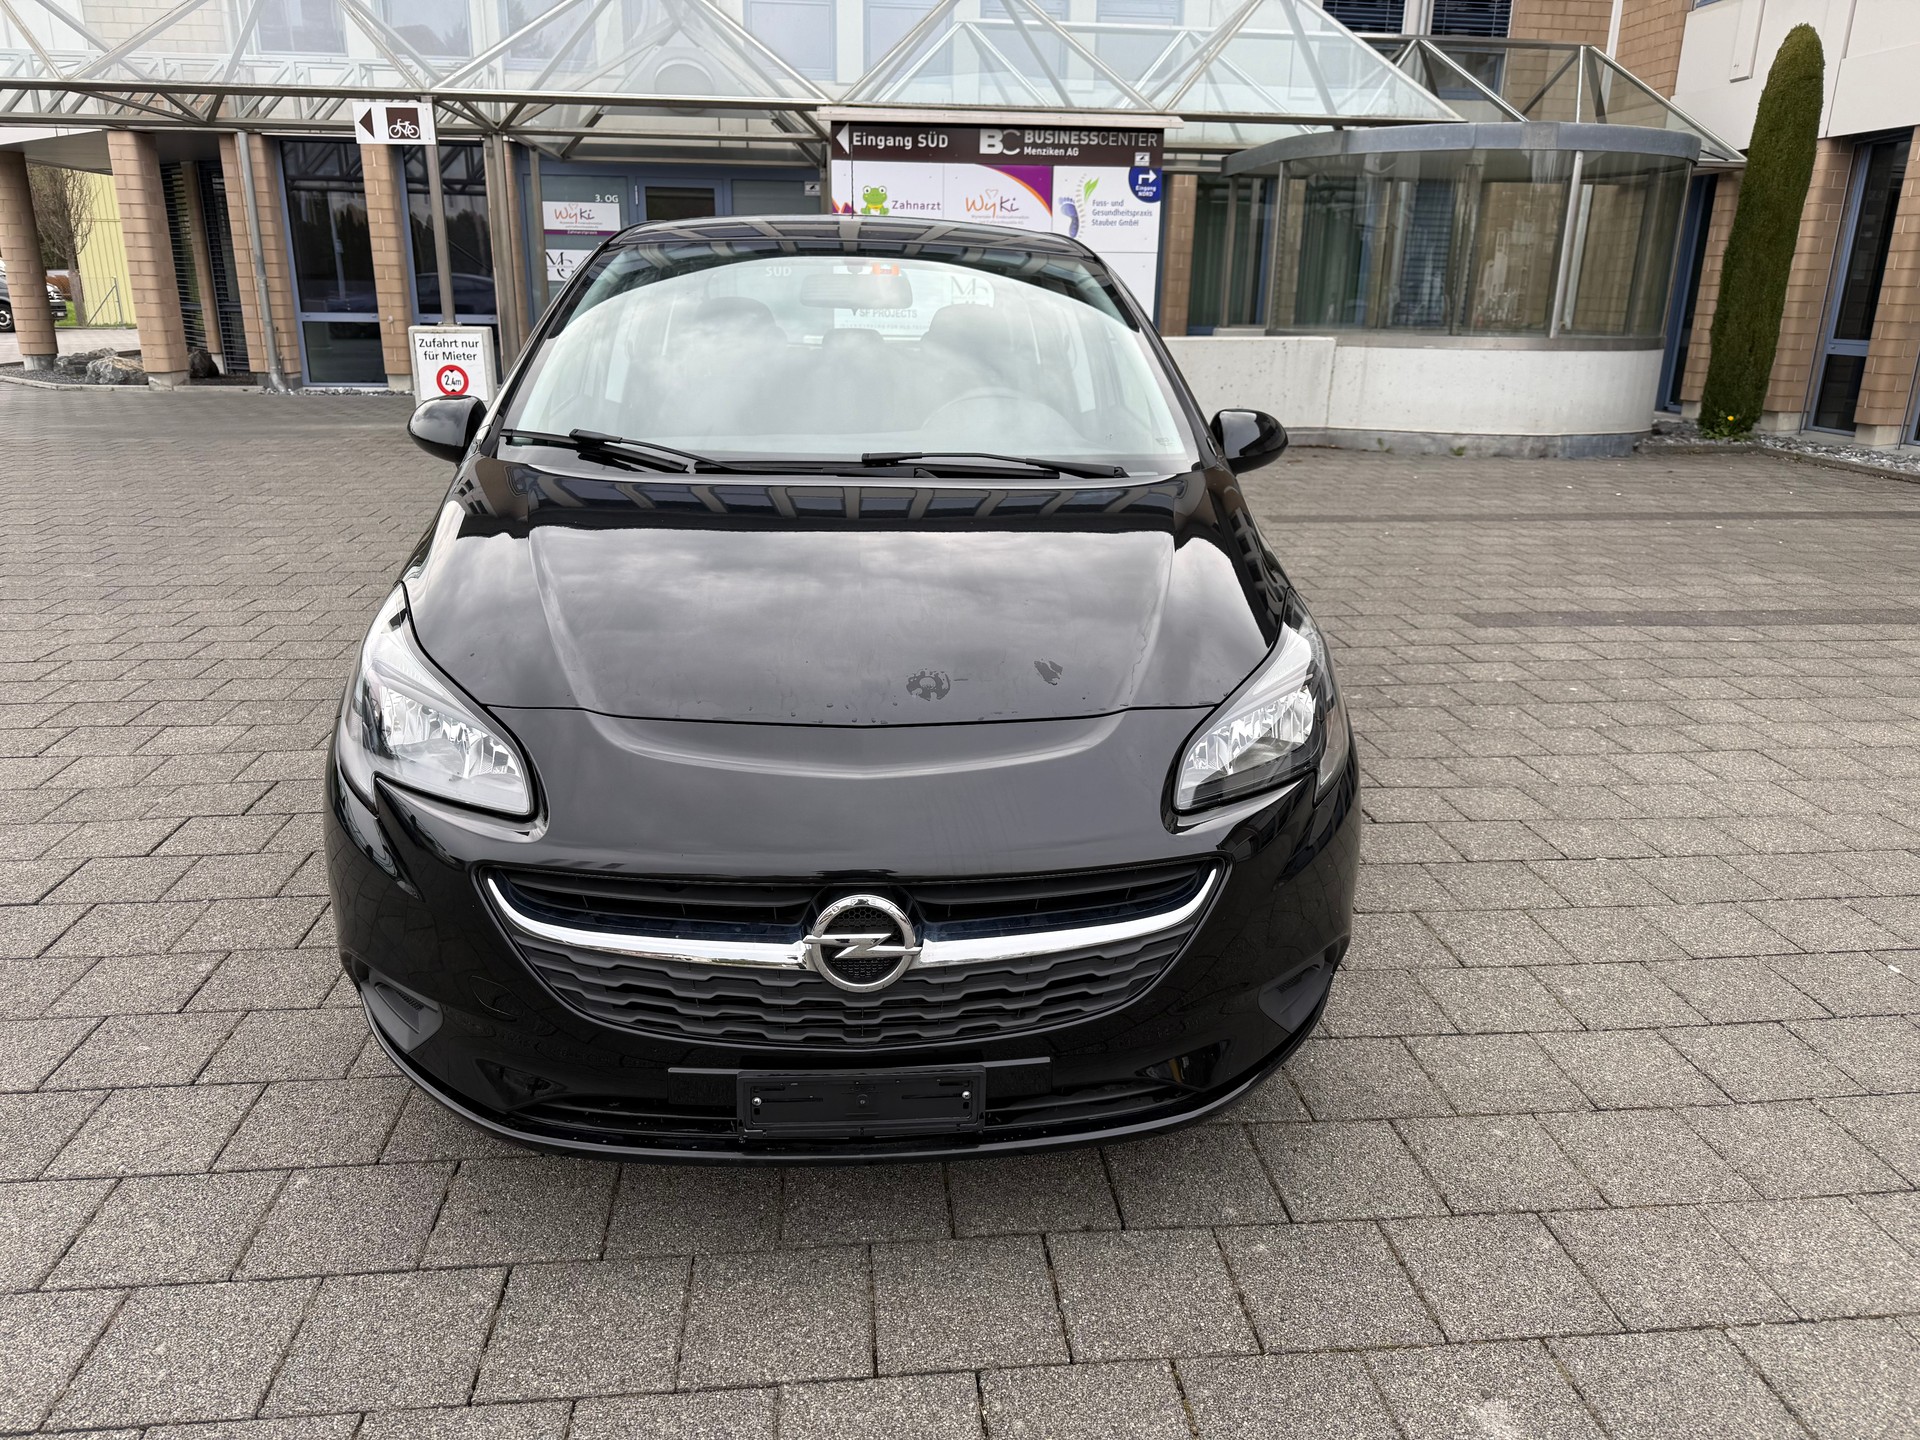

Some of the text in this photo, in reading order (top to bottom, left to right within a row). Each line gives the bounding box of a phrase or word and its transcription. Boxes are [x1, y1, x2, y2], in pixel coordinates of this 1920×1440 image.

[852, 131, 949, 150] Eingang SÜD
[1023, 146, 1079, 157] Menziken AG
[594, 194, 619, 203] 3. OG
[891, 200, 941, 211] Zahnarzt
[1091, 208, 1153, 218] Gesundheitspraxis
[1091, 219, 1140, 227] Stauber GmbH
[872, 309, 918, 319] PROJECTS
[418, 338, 480, 348] Zufahrt nur
[424, 350, 477, 361] für Mieter
